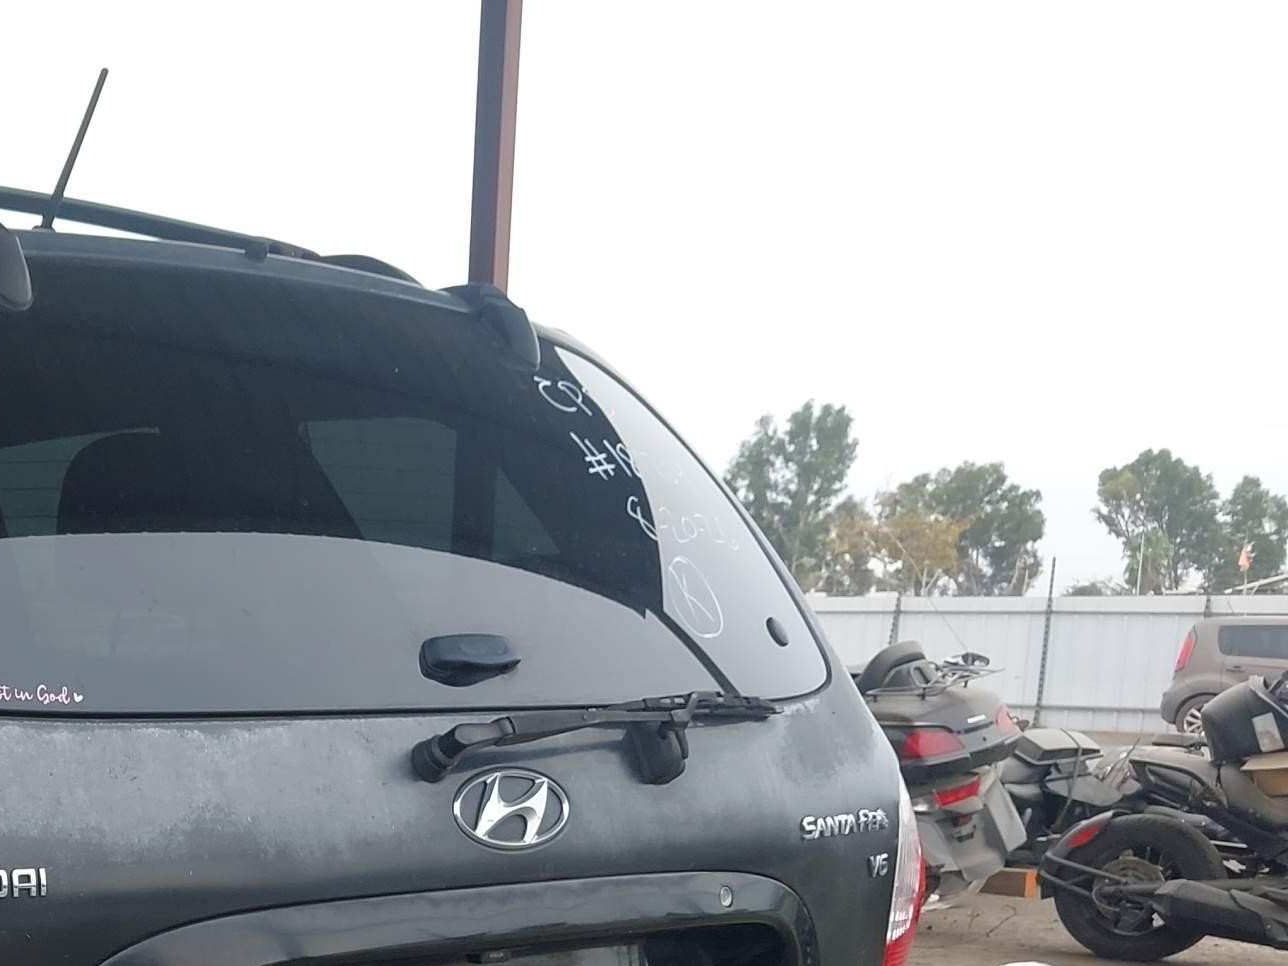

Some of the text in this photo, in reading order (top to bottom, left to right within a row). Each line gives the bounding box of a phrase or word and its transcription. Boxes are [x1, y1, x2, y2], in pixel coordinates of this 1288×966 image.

[14, 687, 34, 701] in
[36, 684, 71, 705] God
[801, 815, 857, 840] SANTA
[869, 852, 889, 878] V6
